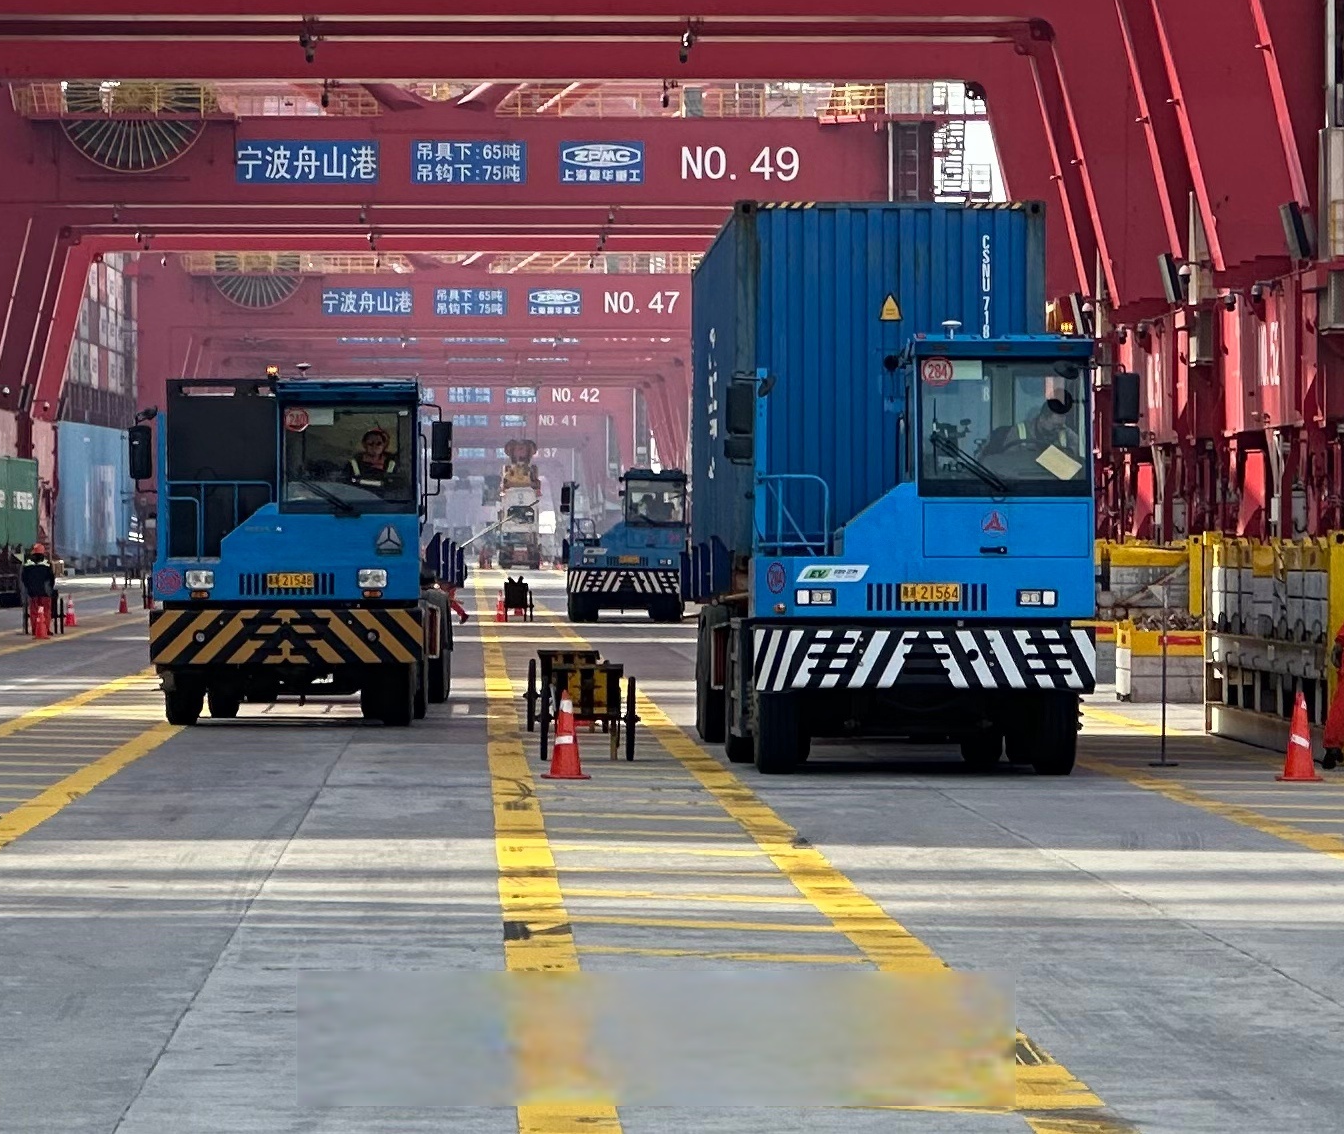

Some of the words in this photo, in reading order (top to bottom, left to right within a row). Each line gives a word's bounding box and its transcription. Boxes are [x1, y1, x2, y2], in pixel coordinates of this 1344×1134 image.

[238, 146, 376, 179] 宁波舟山港
[573, 150, 631, 162] ZPMC
[682, 147, 736, 179] NO.
[750, 147, 799, 181] 49
[981, 234, 991, 292] CSNU
[323, 291, 412, 312] 宁波舟山港
[605, 292, 639, 313] NO.
[648, 292, 679, 313] 47
[927, 363, 948, 379] 284
[552, 388, 574, 402] NO.
[580, 388, 599, 402] 42
